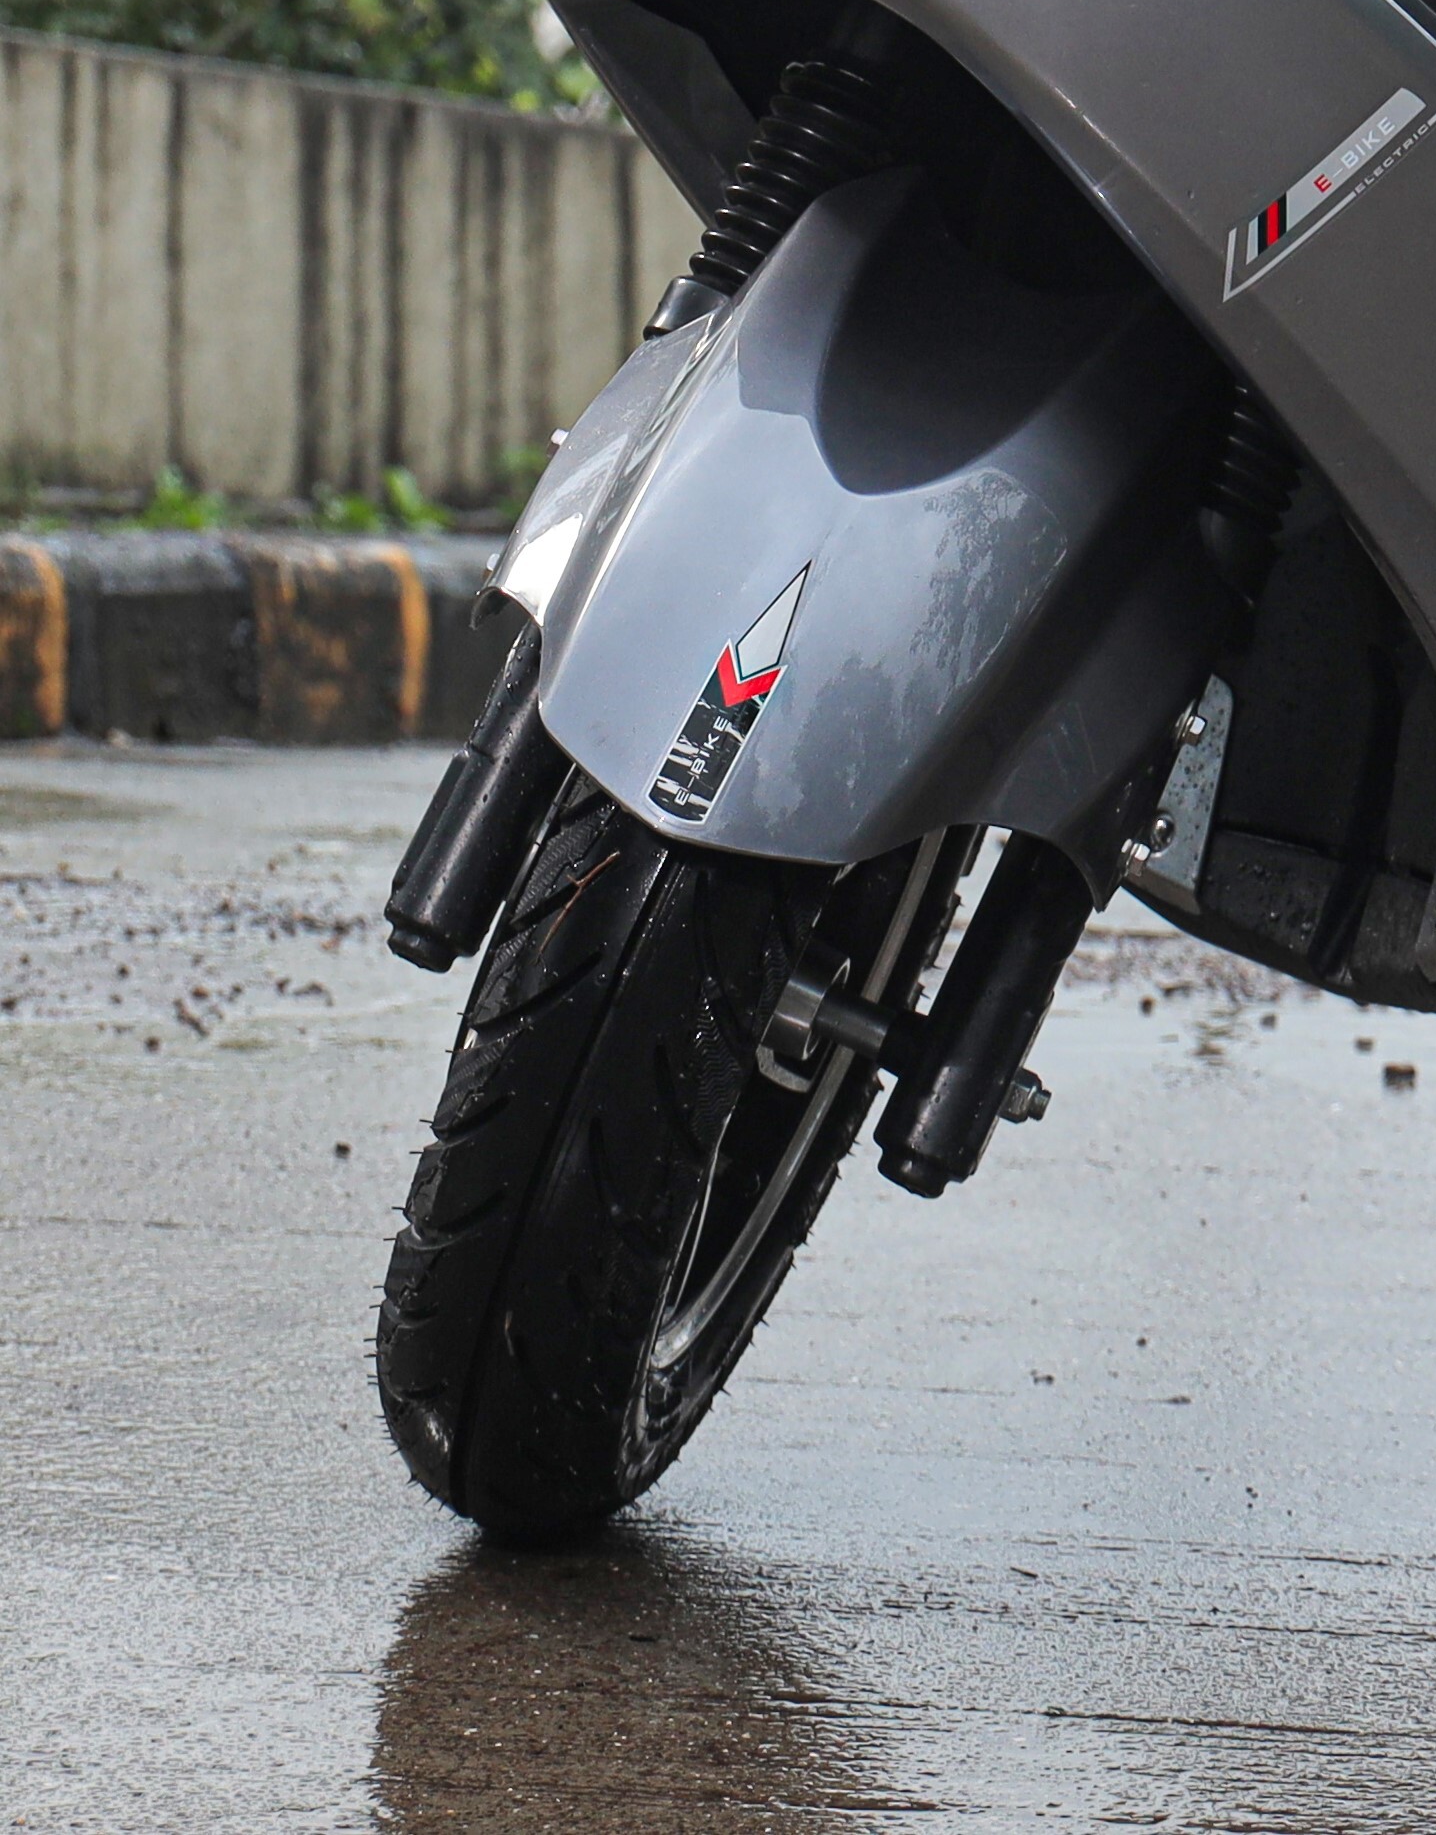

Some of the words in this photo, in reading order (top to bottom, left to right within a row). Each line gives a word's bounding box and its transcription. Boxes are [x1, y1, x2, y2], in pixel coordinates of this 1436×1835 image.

[1313, 116, 1396, 193] E-BIKE
[1354, 123, 1429, 194] ELECTRIC
[673, 715, 729, 807] E-BIKE
